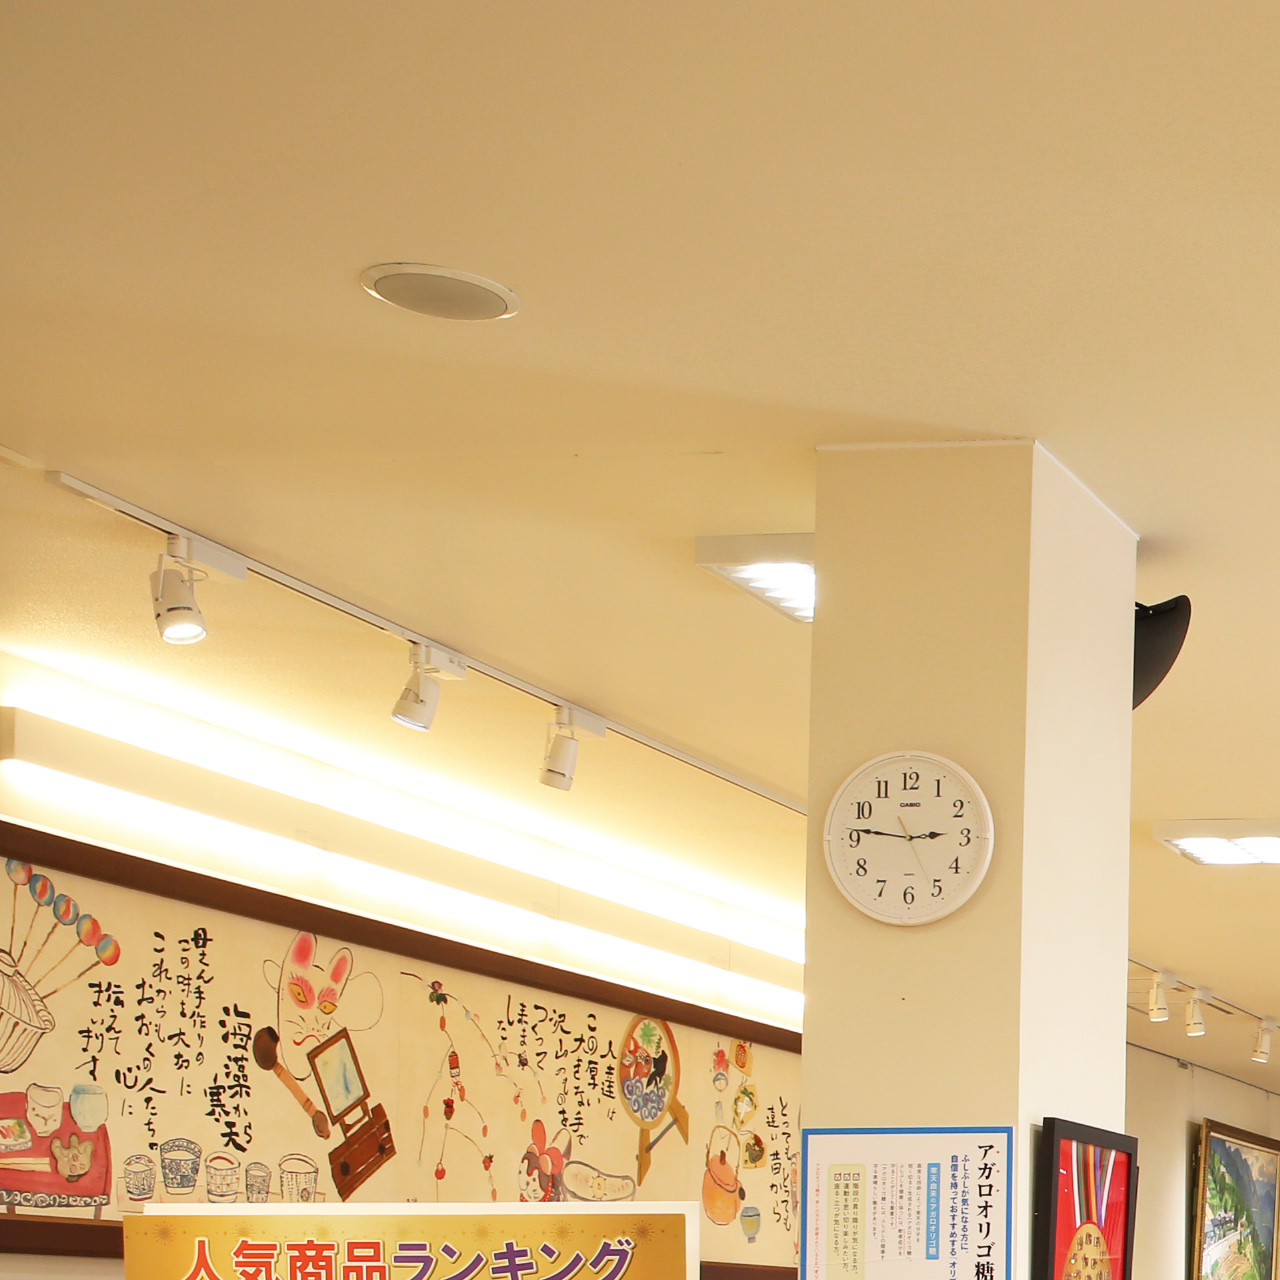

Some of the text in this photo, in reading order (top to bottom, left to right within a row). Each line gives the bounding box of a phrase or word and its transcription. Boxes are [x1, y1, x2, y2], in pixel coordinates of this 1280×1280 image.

[876, 780, 890, 799] 11
[901, 771, 920, 790] 12
[935, 778, 943, 798] 1
[855, 800, 872, 819] 10
[952, 799, 964, 818] 2
[848, 829, 861, 848] 9
[958, 827, 971, 847] 3
[856, 858, 868, 876] 8
[948, 856, 961, 874] 4
[876, 879, 887, 898] 7
[903, 886, 915, 905] 6
[931, 879, 943, 898] 5
[152, 931, 173, 1043] これからも
[75, 980, 105, 1082] まいります
[204, 1073, 248, 1153] 寒天
[960, 1154, 970, 1254] ふしぶしが気になる方に。
